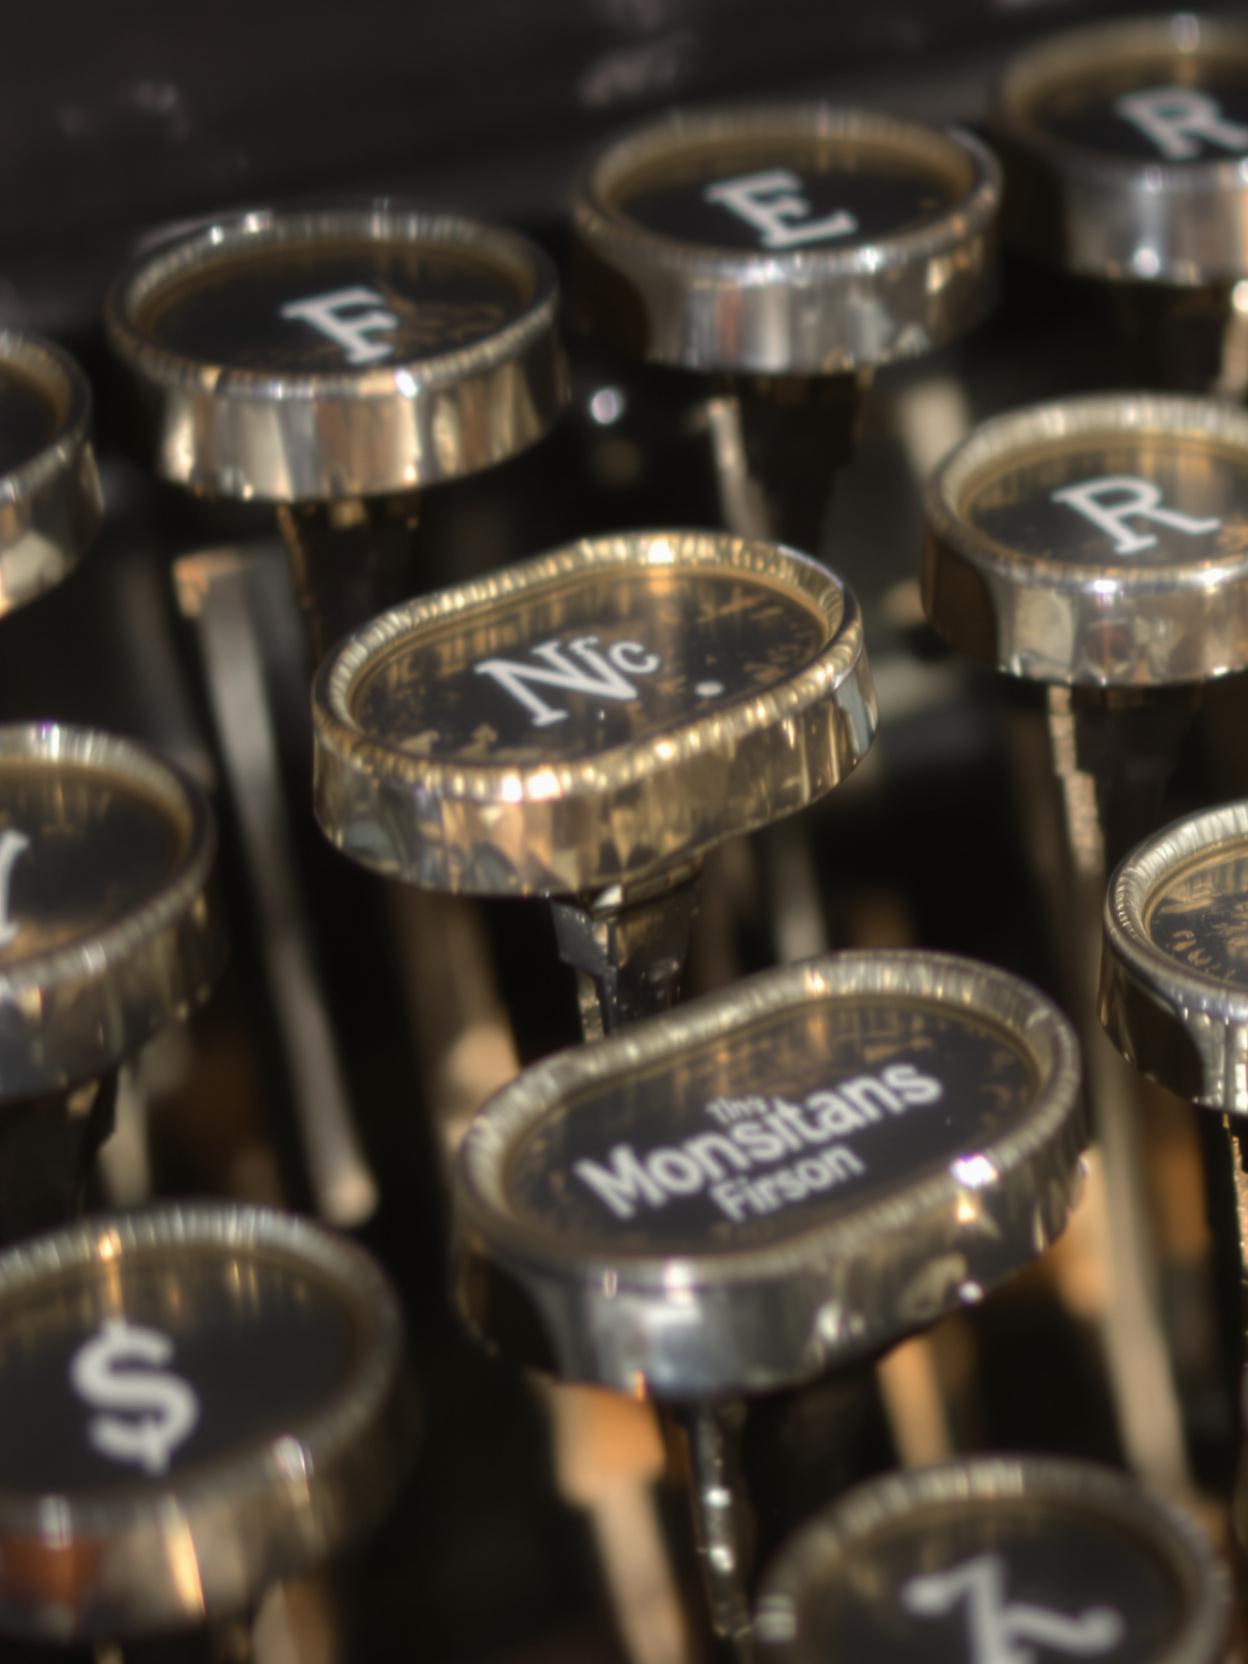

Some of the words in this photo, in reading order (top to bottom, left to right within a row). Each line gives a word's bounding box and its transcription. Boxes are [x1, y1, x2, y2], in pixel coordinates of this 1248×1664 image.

[707, 170, 857, 249] E
[282, 286, 398, 367] F
[1052, 474, 1221, 556] R
[70, 1310, 198, 1475] $
